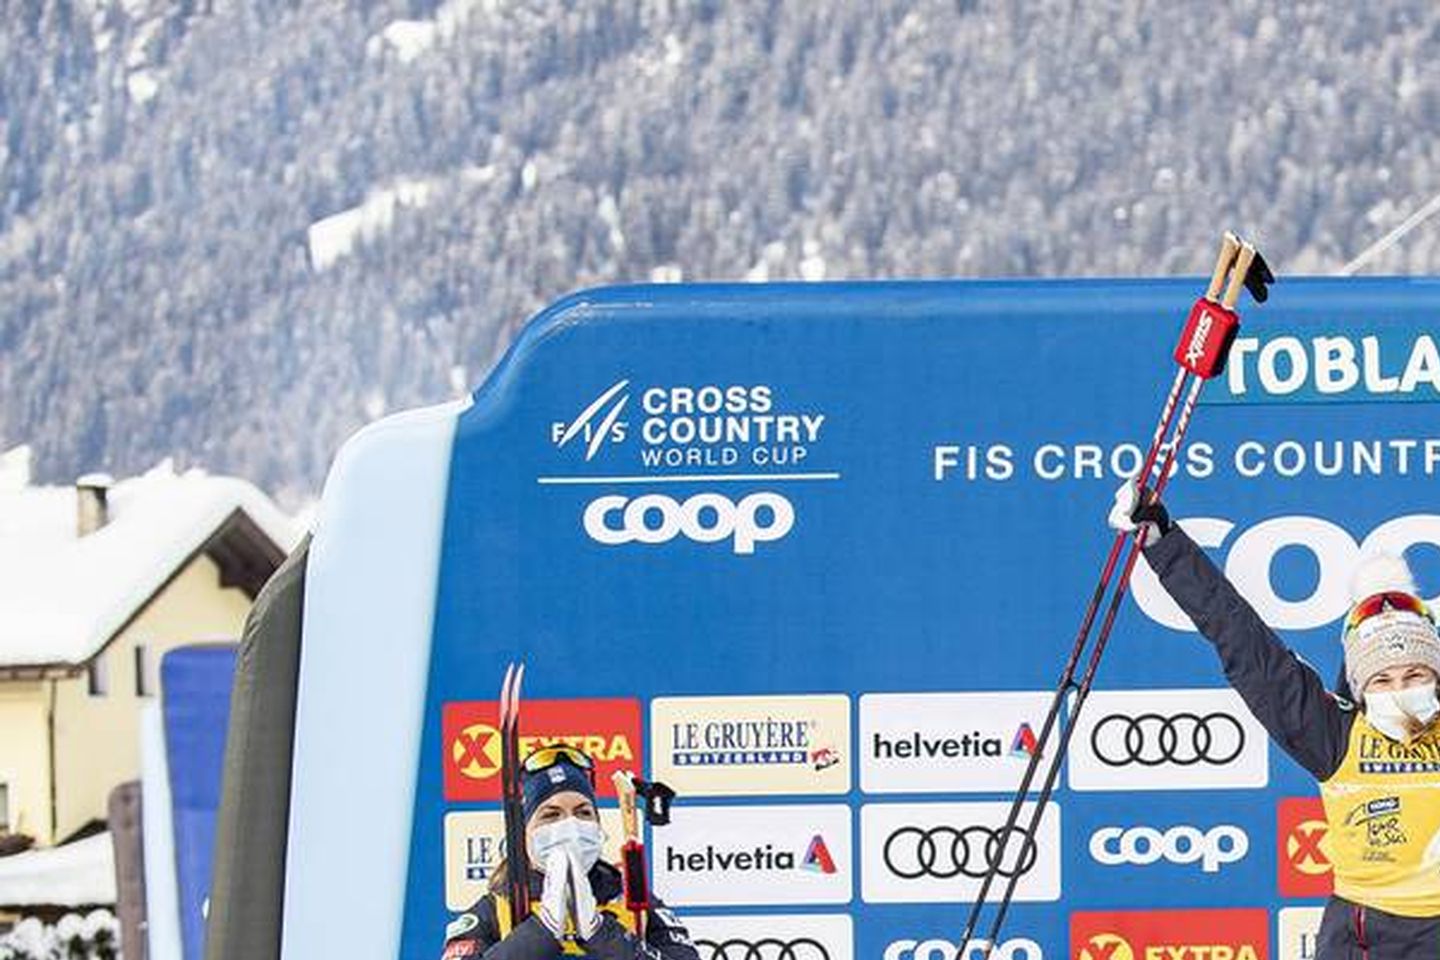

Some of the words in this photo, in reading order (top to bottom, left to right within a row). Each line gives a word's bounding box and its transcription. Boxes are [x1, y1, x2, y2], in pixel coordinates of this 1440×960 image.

[641, 386, 772, 415] CROSS
[641, 415, 826, 444] COUNTRY
[641, 449, 740, 467] WORLD
[753, 447, 808, 465] CUP
[935, 445, 1014, 481] FIS
[1034, 442, 1216, 481] CROSS
[583, 492, 795, 555] coop
[673, 723, 699, 749] LE
[704, 716, 808, 748] GRUYÈRE
[873, 732, 1001, 758] helvetia
[666, 846, 795, 872] helvetia
[1088, 825, 1250, 872] coop
